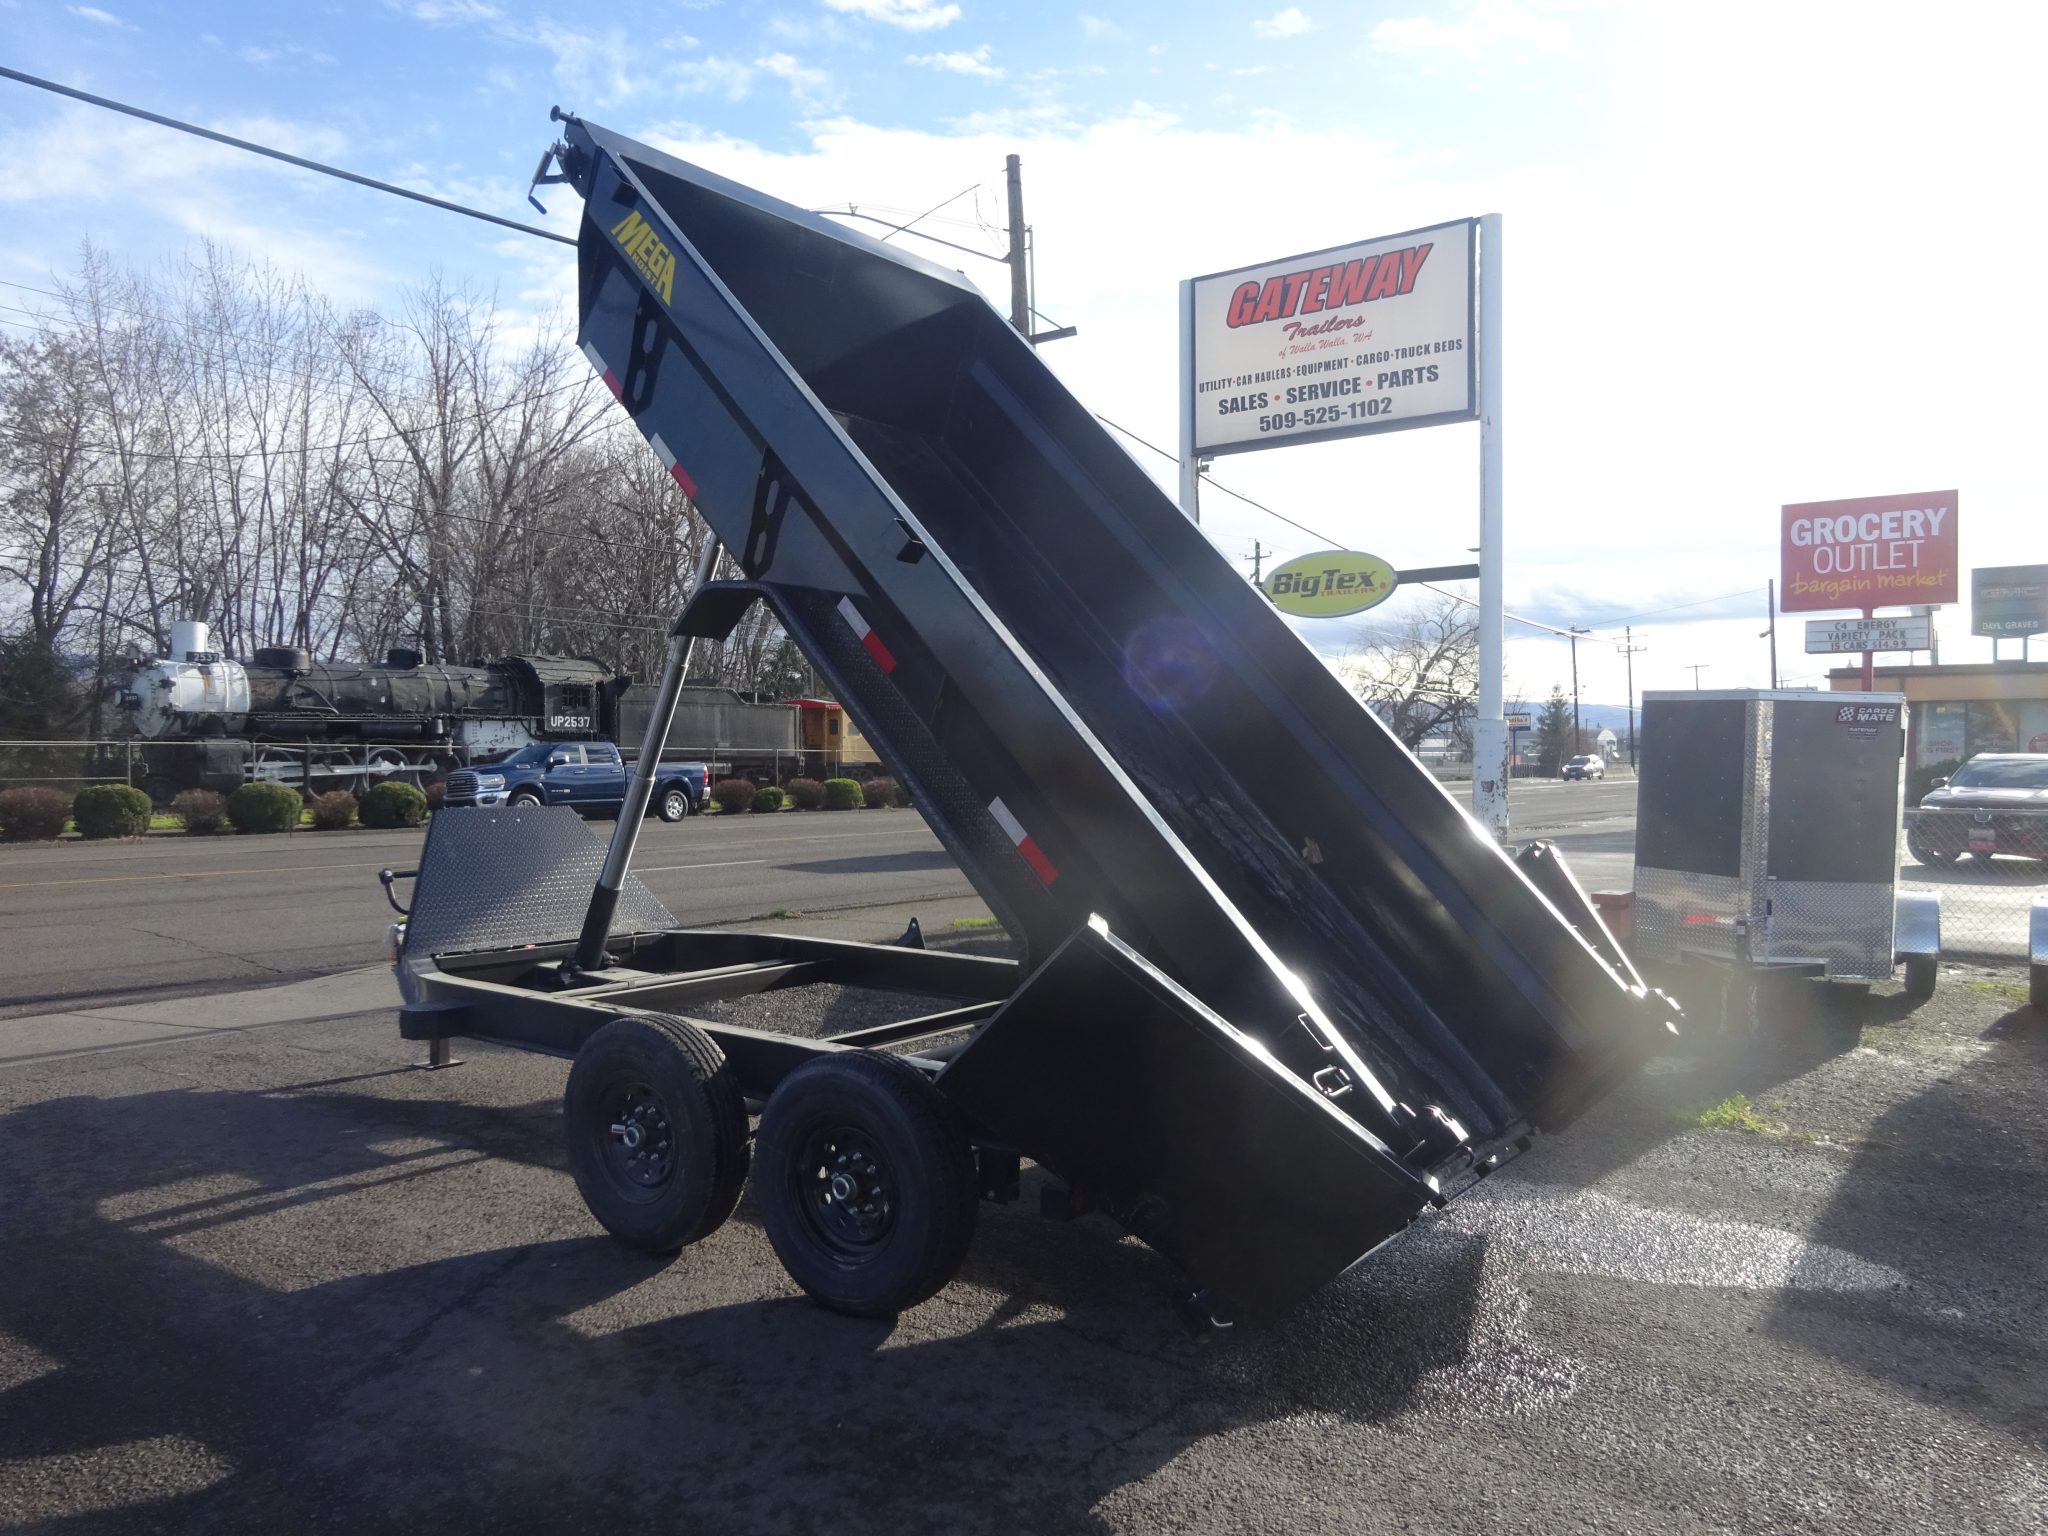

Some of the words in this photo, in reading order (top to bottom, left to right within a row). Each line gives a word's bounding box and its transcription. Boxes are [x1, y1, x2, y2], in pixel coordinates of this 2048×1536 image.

[610, 210, 676, 307] MEGA
[1226, 243, 1434, 329] GATEWAY
[1289, 342, 1316, 355] Walla
[1353, 329, 1373, 344] WA
[1199, 378, 1232, 393] UTILITY
[1236, 374, 1252, 387] CAR
[1255, 367, 1292, 383] HAULERS
[1296, 358, 1348, 377] EQUIPMENT
[1356, 350, 1389, 366] CARGO
[1394, 343, 1431, 360] TRUCK
[1434, 338, 1463, 354] BEDS
[1218, 392, 1269, 415] SALES
[1286, 377, 1361, 404] SERVICE
[1377, 364, 1439, 390] PARTS
[1259, 397, 1393, 433] 509-525-1102
[1790, 507, 1947, 547] GROCERY
[1812, 539, 1925, 575] OUTLET
[1789, 572, 1871, 600] bargain
[1877, 568, 1947, 588] market
[1827, 631, 1870, 641] VARIETY
[1879, 629, 1907, 639] PACK
[1834, 622, 1847, 631] C4
[1857, 620, 1897, 630] ENERGY
[193, 652, 219, 662] 2537
[1843, 640, 1868, 650] CANS
[550, 715, 591, 728] UP2537
[1857, 713, 1894, 721] MATE
